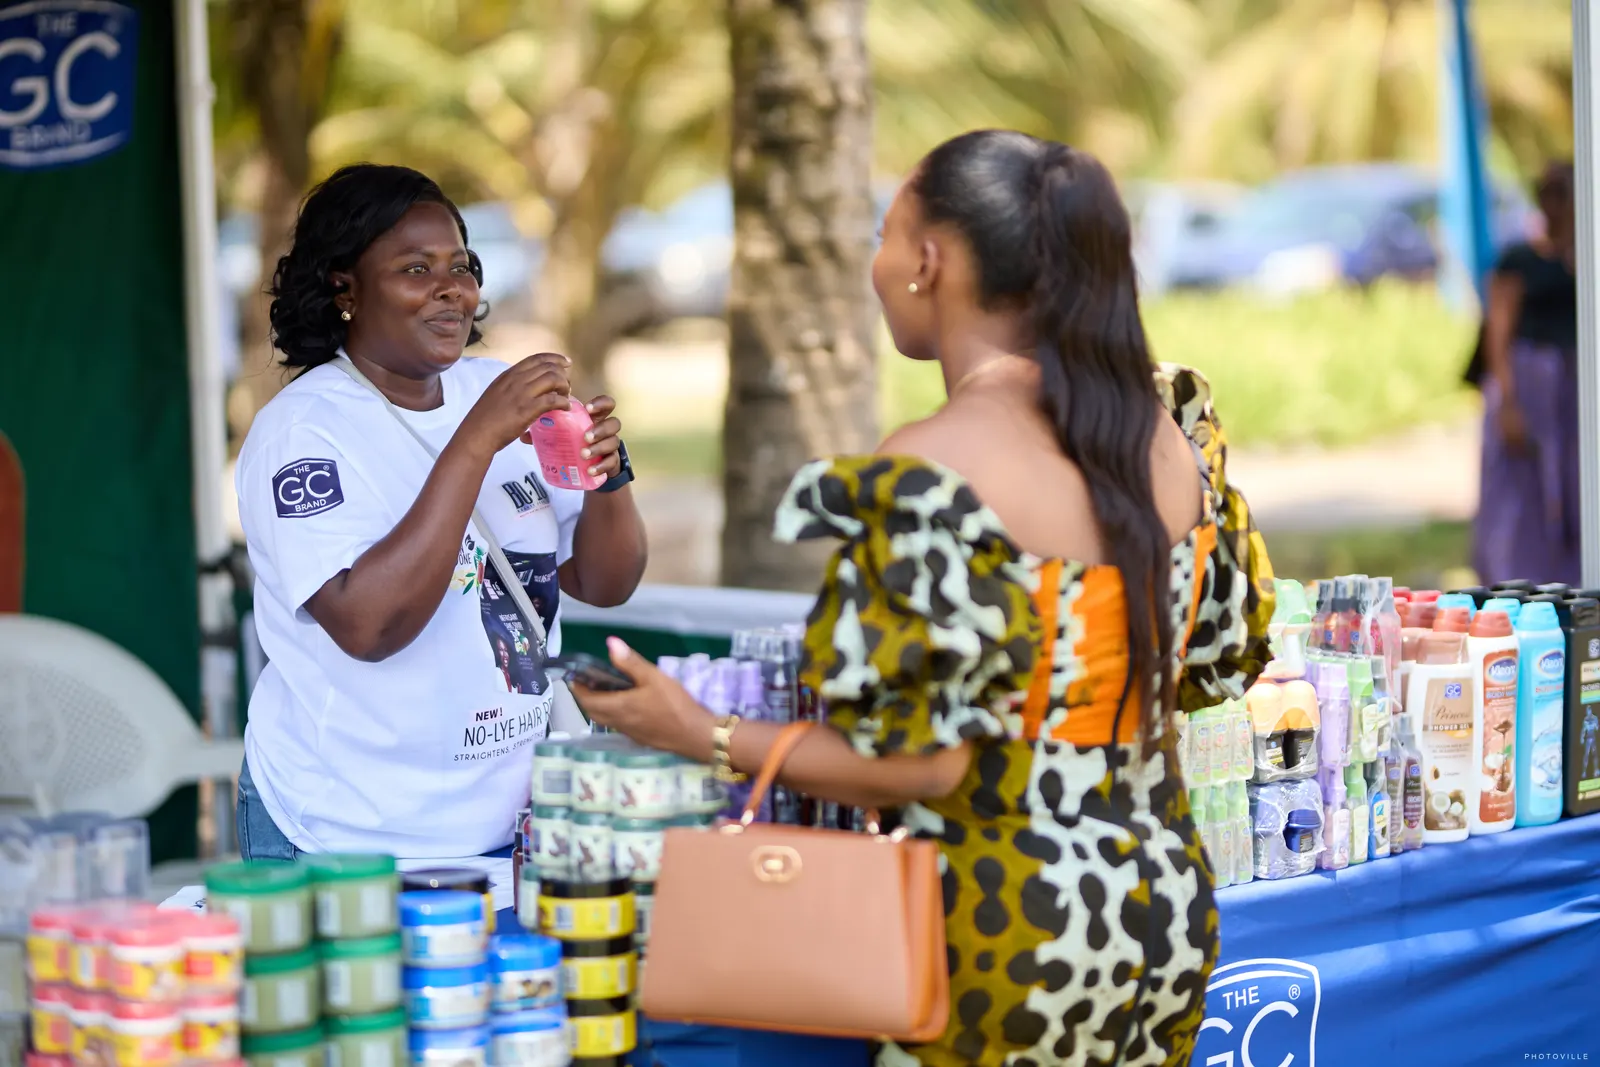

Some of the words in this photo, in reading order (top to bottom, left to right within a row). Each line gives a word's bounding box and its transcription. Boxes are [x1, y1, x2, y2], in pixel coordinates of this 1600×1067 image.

[0, 31, 120, 125] GC
[294, 464, 310, 475] THE
[278, 470, 334, 505] GC
[294, 499, 327, 512] BRAND
[464, 718, 515, 747] NO-LYE
[518, 706, 542, 736] HAIR
[1221, 985, 1260, 1010] THE
